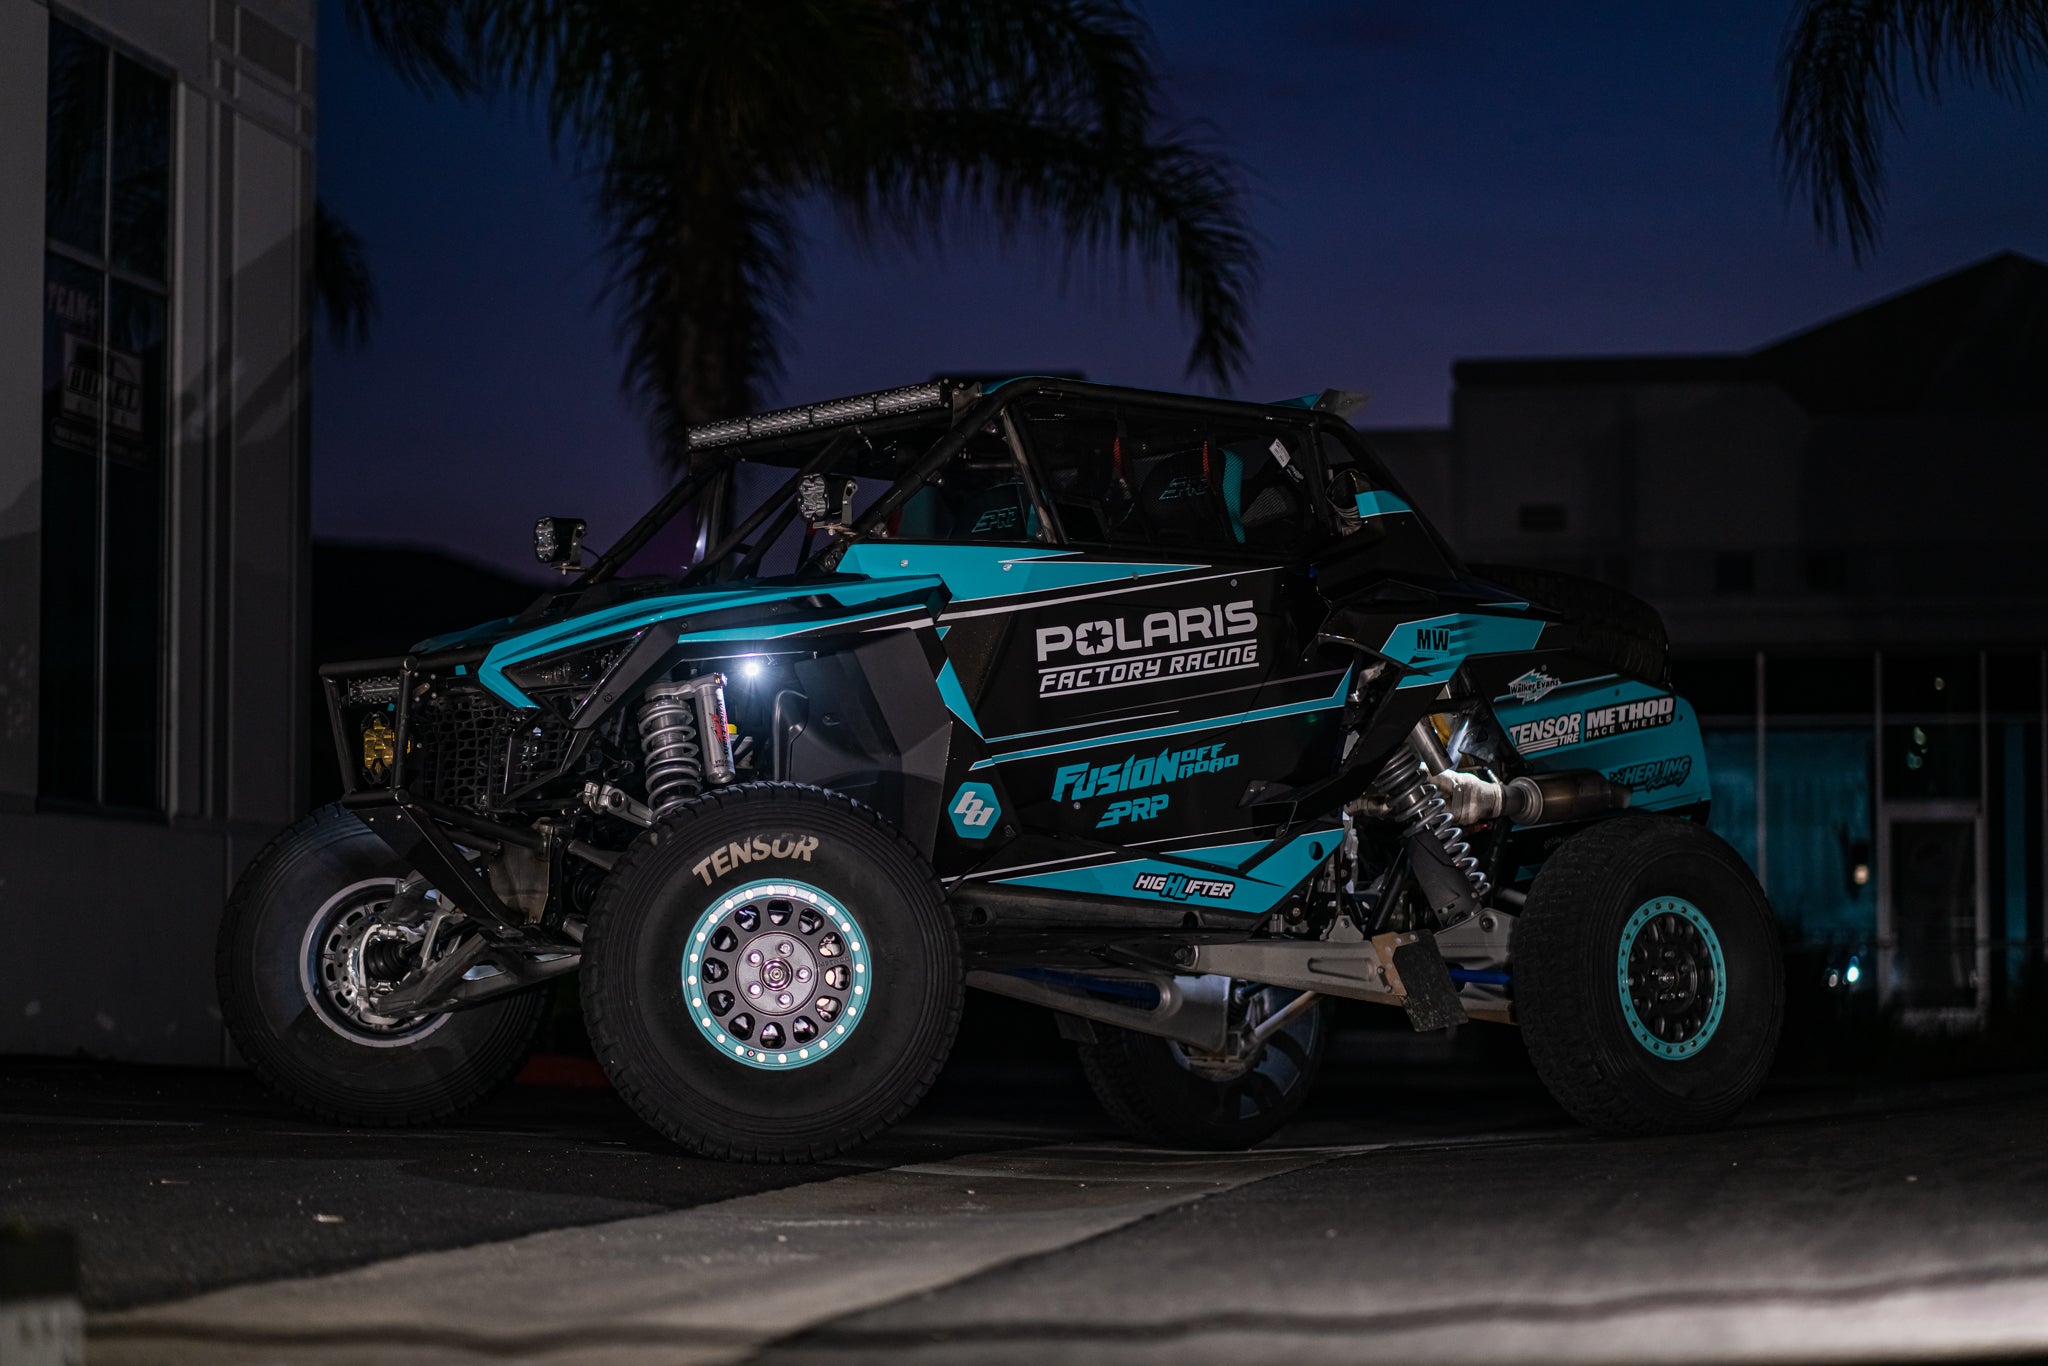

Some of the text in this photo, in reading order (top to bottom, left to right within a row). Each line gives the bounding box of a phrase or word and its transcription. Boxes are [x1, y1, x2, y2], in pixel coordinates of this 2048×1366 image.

[1036, 600, 1258, 662] POLARIS
[1417, 629, 1449, 651] MW
[1039, 645, 1258, 693] FACTORY RACING
[1509, 713, 1582, 746] TENSOR
[1586, 697, 1675, 730] METHOD
[1586, 714, 1672, 740] RACE WHEELS
[1180, 742, 1227, 762] OFF
[1557, 732, 1580, 746] TIRE
[1178, 753, 1240, 779] ROAD
[1095, 793, 1170, 829] PRP
[692, 833, 819, 886] TENSOR
